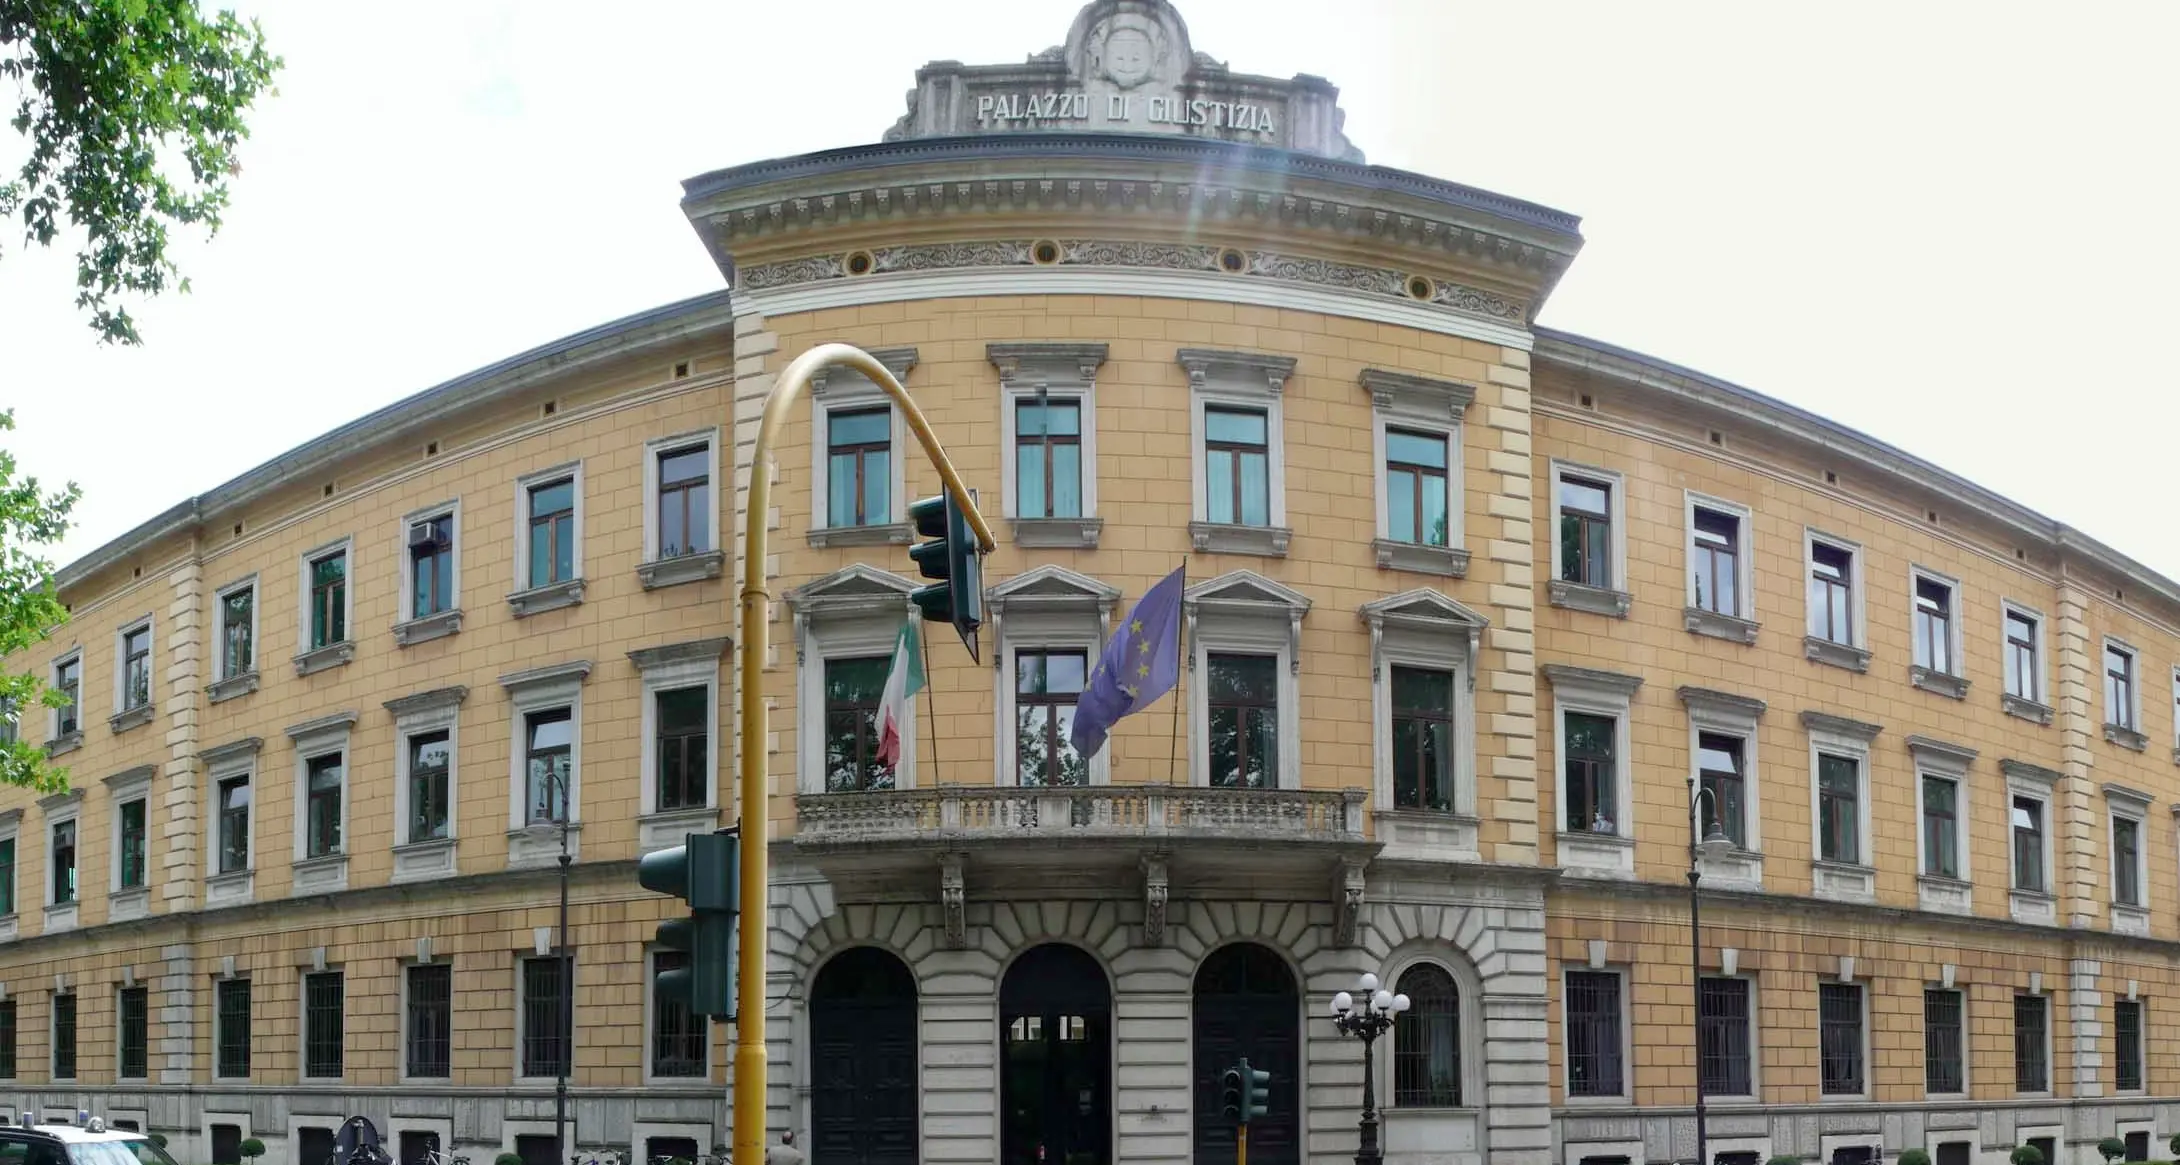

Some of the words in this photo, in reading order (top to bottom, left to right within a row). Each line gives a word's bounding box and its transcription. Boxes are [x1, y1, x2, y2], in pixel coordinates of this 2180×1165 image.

[977, 93, 1089, 121] PALAZZO
[1107, 95, 1129, 121] DI
[1149, 96, 1275, 133] GIUSTIZIA
